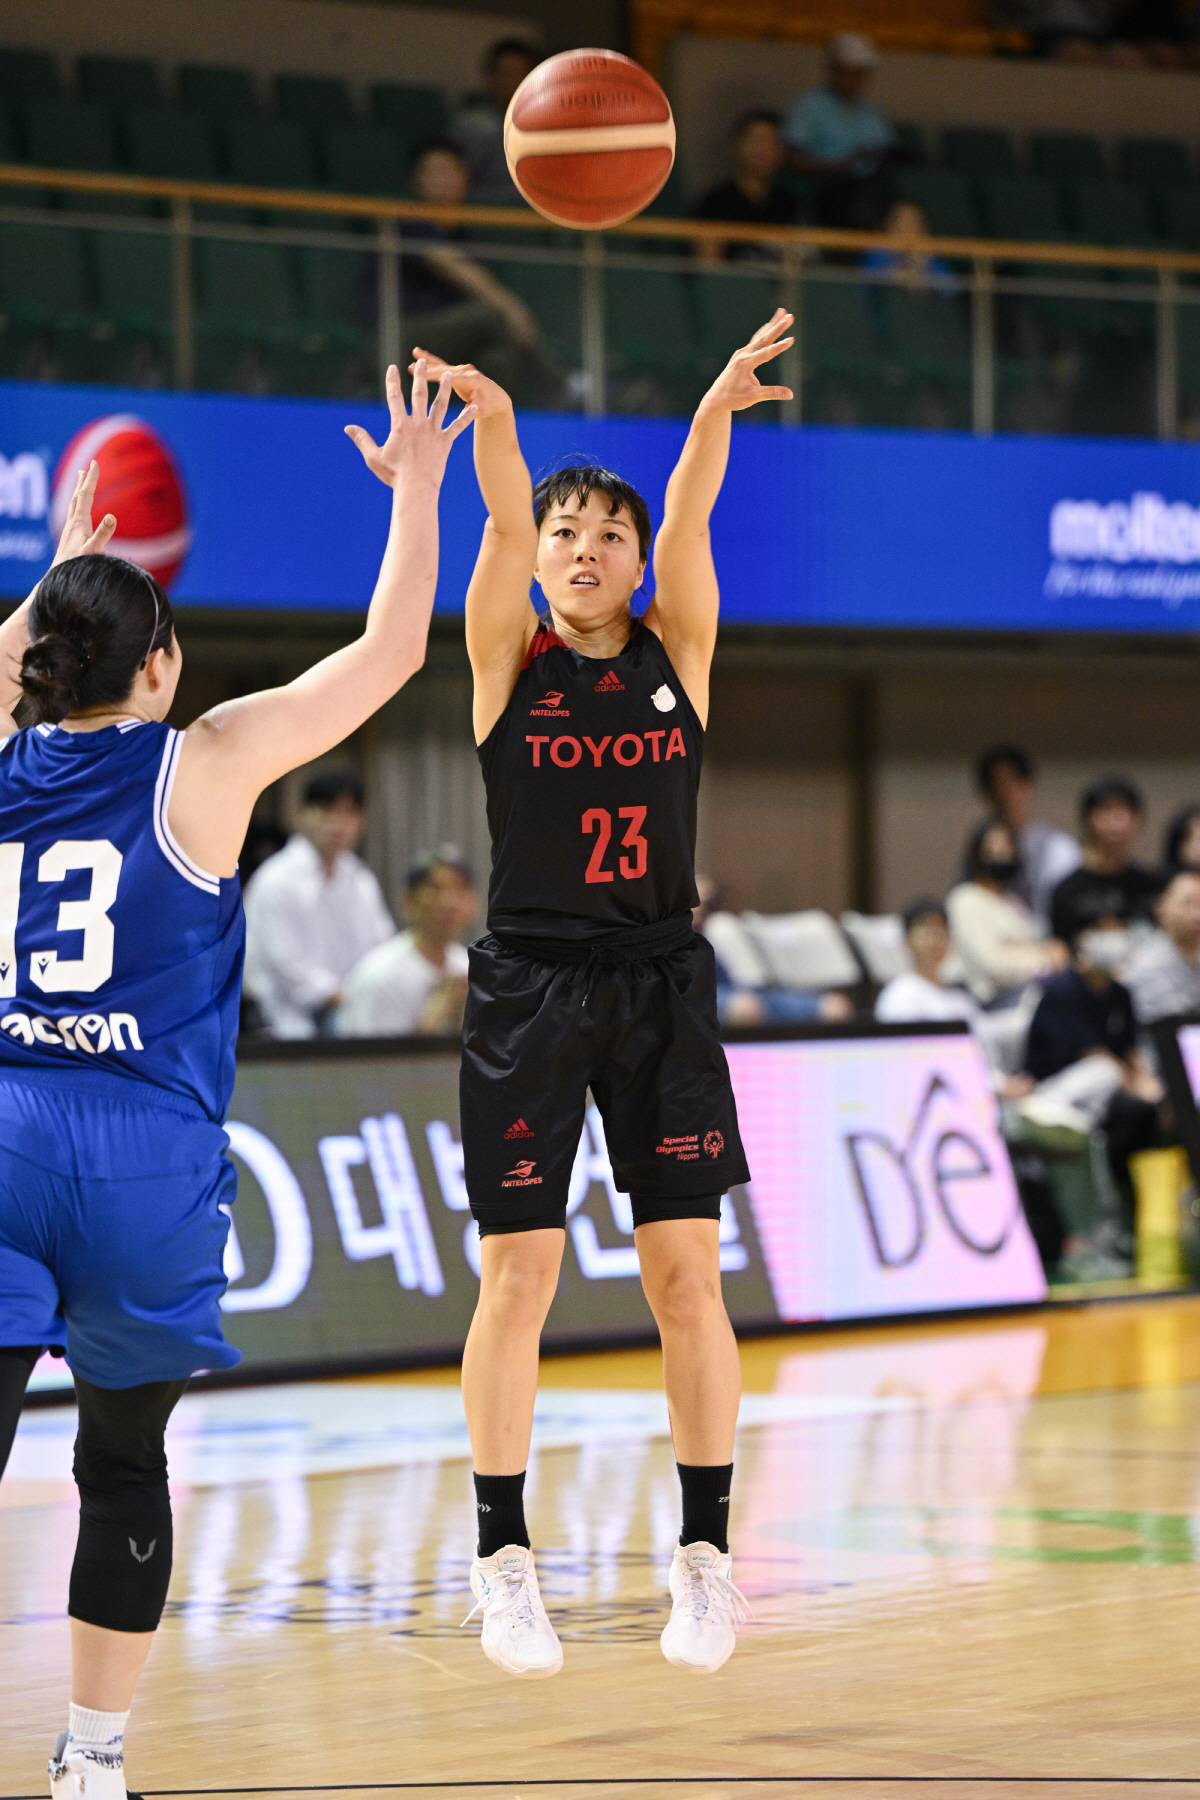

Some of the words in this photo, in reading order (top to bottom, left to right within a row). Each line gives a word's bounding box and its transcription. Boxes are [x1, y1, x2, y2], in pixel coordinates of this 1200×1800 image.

[594, 683, 625, 692] adidas
[529, 709, 570, 717] ANTELOPES
[525, 727, 687, 769] TOYOTA
[581, 805, 648, 884] 23
[0, 839, 124, 998] 13
[503, 1130, 535, 1140] adidas
[663, 1134, 699, 1146] Special
[656, 1144, 699, 1155] Olympics
[677, 1152, 700, 1161] Nippon
[501, 1176, 543, 1188] ANTELOPES
